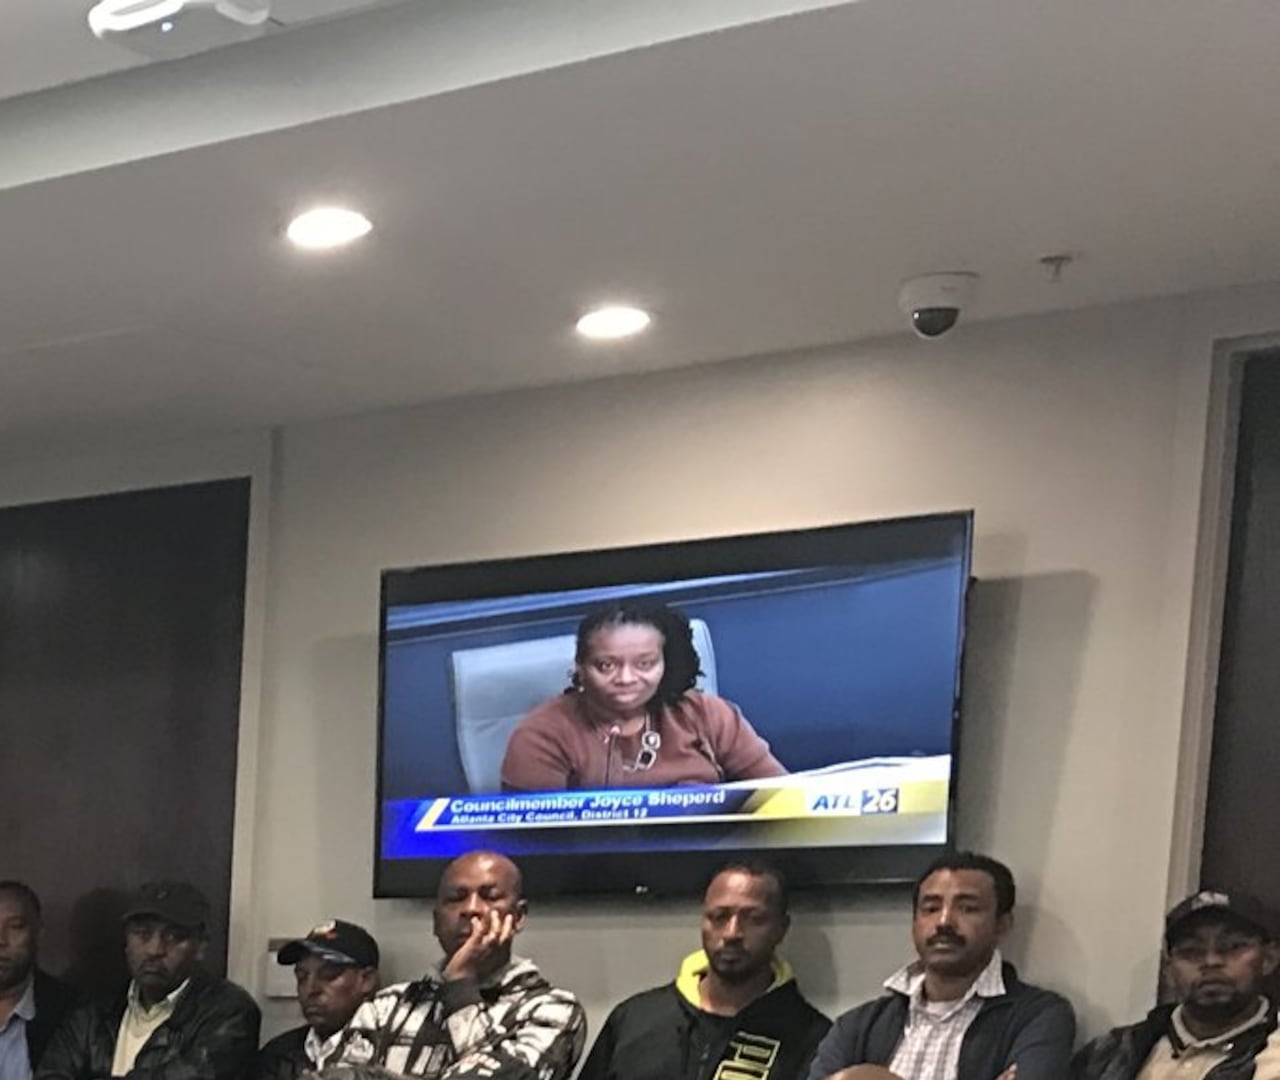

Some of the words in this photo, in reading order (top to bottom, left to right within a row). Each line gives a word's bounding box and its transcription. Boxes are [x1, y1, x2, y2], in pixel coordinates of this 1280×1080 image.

[450, 797, 584, 813] Councilmember
[590, 794, 642, 810] Joyce
[861, 788, 899, 813] 26
